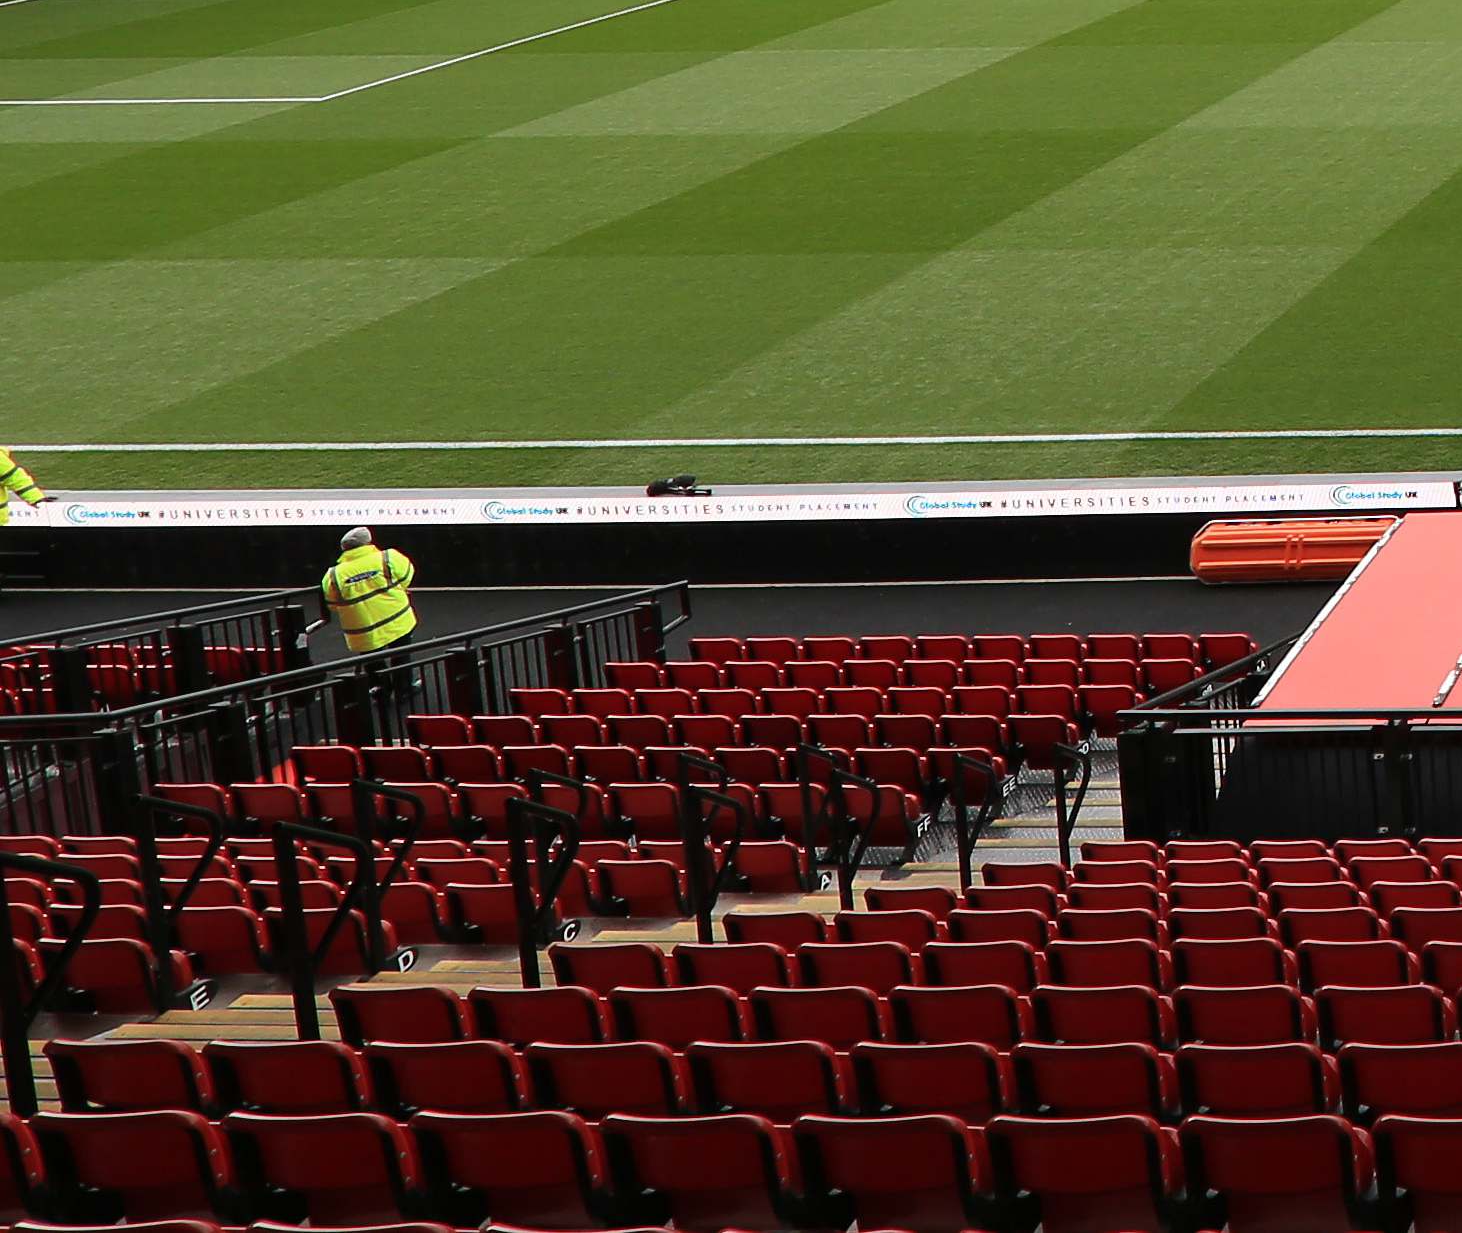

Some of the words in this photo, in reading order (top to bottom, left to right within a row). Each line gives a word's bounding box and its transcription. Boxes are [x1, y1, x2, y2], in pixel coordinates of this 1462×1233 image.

[1346, 491, 1376, 499] Global
[1378, 491, 1402, 500] Study
[496, 507, 528, 515] Global
[528, 507, 553, 516] Study
[920, 501, 950, 509] Global
[952, 500, 976, 510] Study
[80, 510, 110, 518] Global
[111, 510, 136, 520] Study
[1002, 776, 1016, 797] EE
[916, 816, 932, 838] FF
[820, 874, 830, 891] A
[563, 923, 577, 942] C
[398, 950, 414, 973] D
[190, 986, 211, 1012] E
